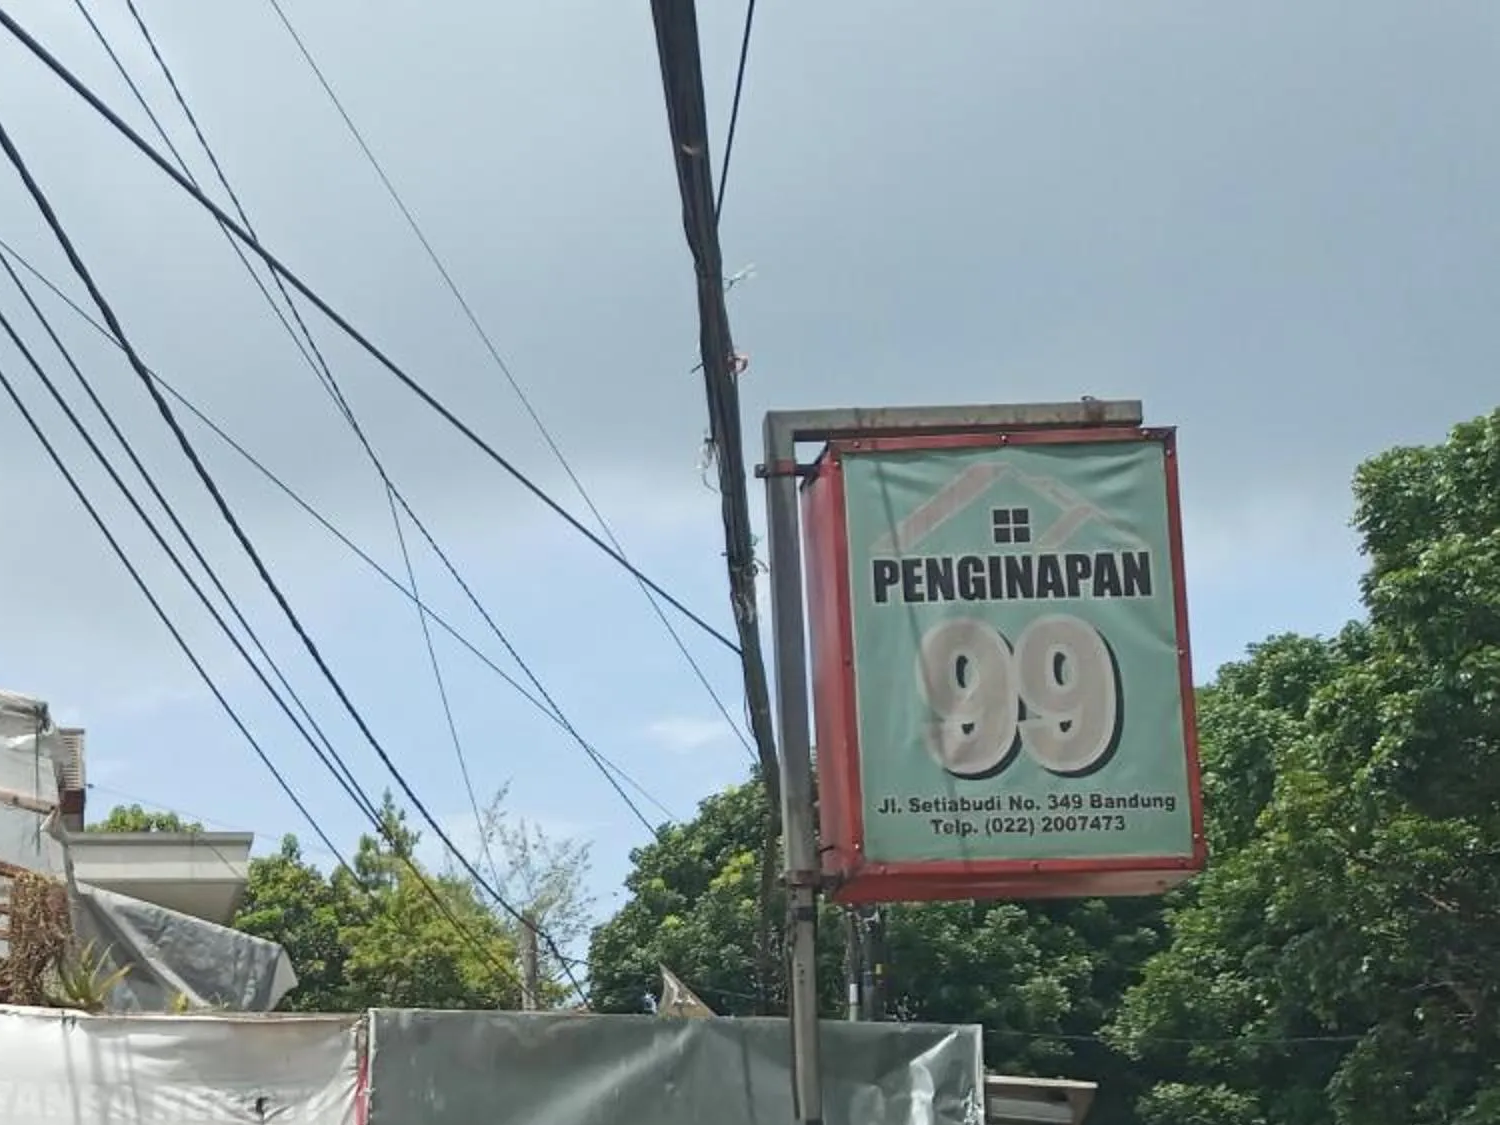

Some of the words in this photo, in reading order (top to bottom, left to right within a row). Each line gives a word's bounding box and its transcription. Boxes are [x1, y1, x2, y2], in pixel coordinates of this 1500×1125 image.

[872, 551, 1152, 603] PENGINAPAN
[916, 614, 1124, 779] 99
[878, 797, 902, 814] Jl.
[908, 795, 1002, 814] Setiabudi
[1008, 794, 1041, 812] No.
[1047, 793, 1083, 811] 349
[1089, 792, 1177, 812] Bandung
[930, 818, 978, 837] Telp.
[985, 816, 1035, 838] (022)
[1041, 815, 1126, 833] 2007473
